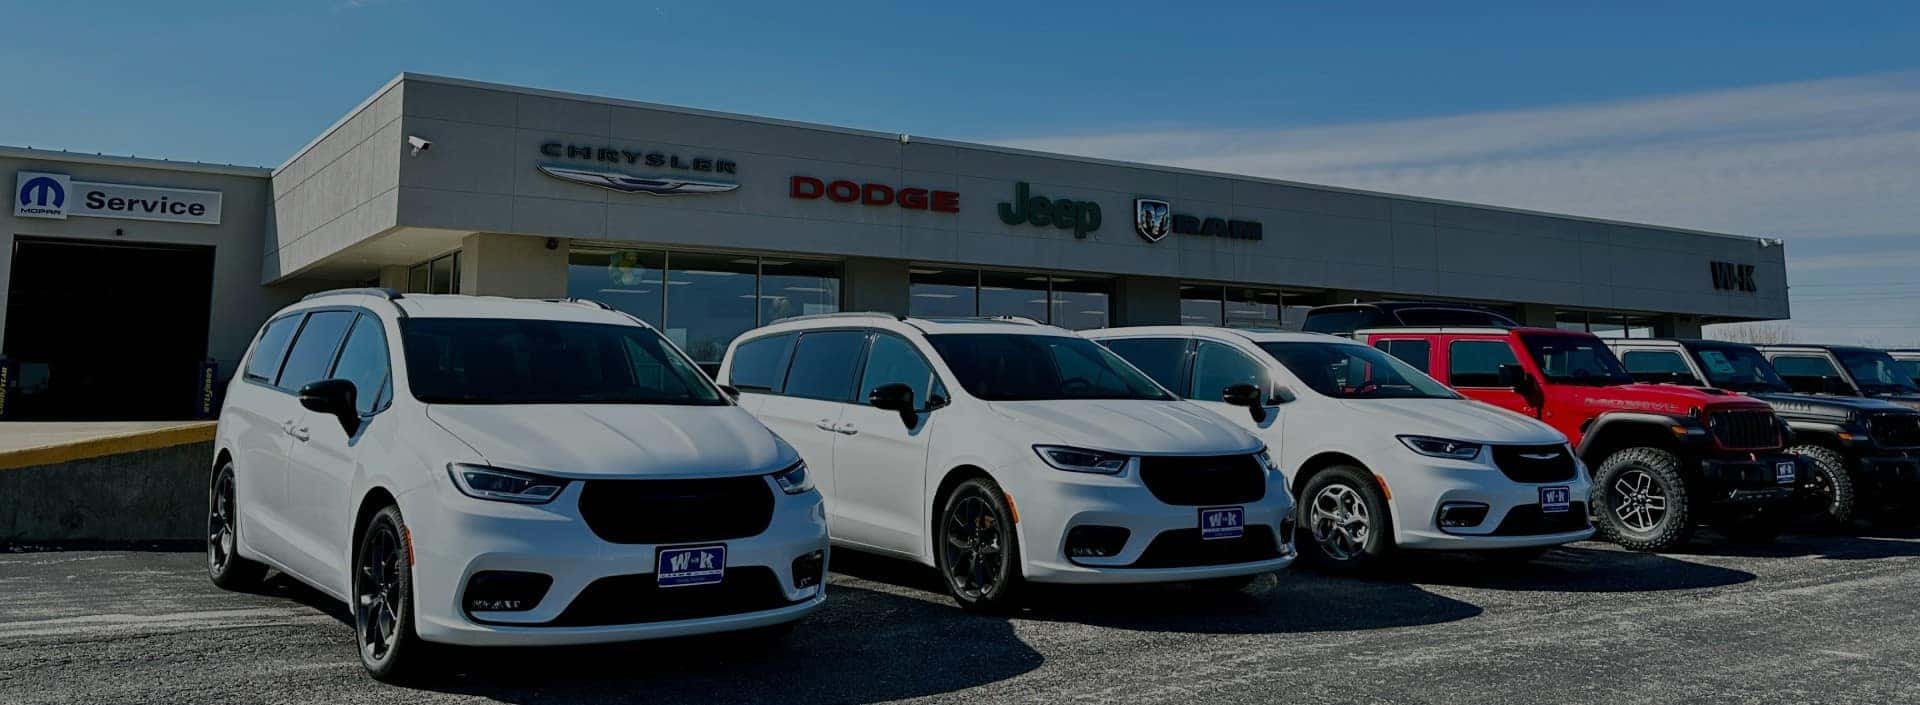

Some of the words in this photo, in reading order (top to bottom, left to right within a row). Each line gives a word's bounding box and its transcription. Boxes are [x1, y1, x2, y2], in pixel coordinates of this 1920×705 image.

[540, 142, 738, 175] CHRYSLER
[86, 191, 206, 217] Service
[789, 174, 961, 213] DODGE
[20, 207, 62, 216] MOPAR
[998, 181, 1102, 239] Jeep
[1172, 213, 1263, 241] RAM
